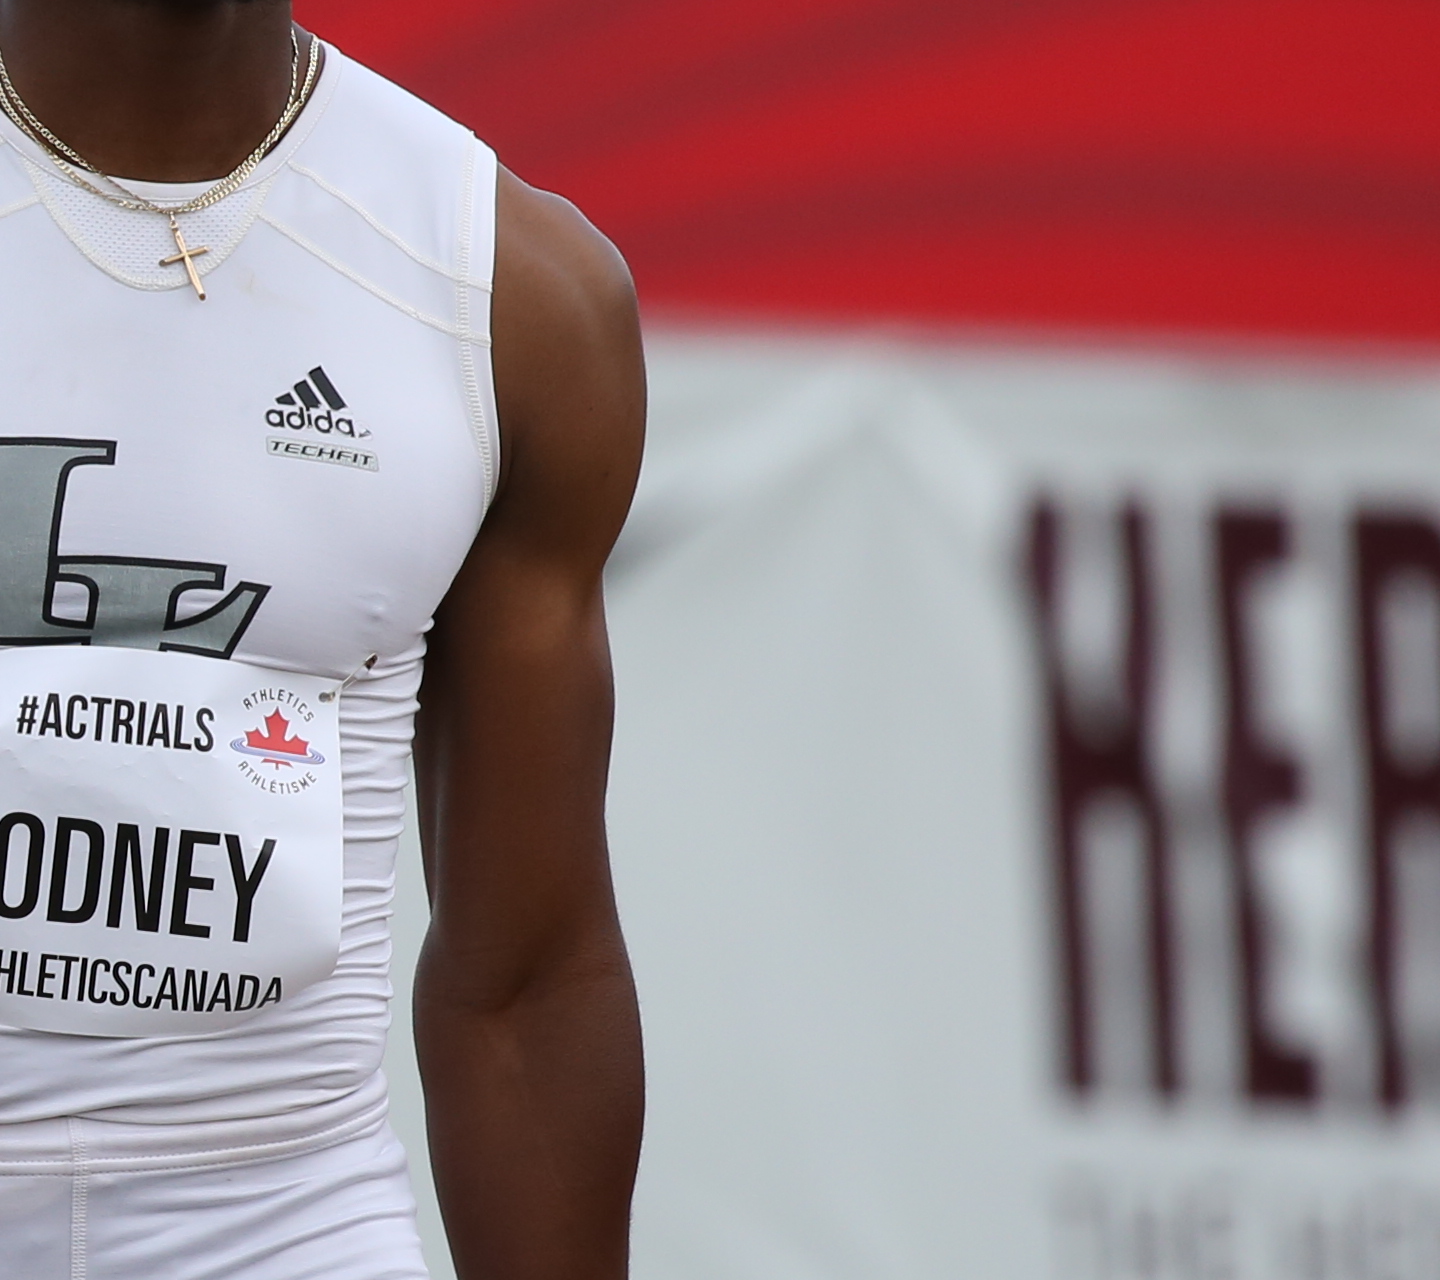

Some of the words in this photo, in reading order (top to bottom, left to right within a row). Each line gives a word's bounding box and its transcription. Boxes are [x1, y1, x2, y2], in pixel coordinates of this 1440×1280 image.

[265, 406, 372, 439] adida
[271, 440, 374, 466] TECHFIT
[16, 692, 215, 752] #ACTRIALS
[242, 687, 315, 722] ATHLETICS
[238, 760, 317, 795] ATHLÉTISME
